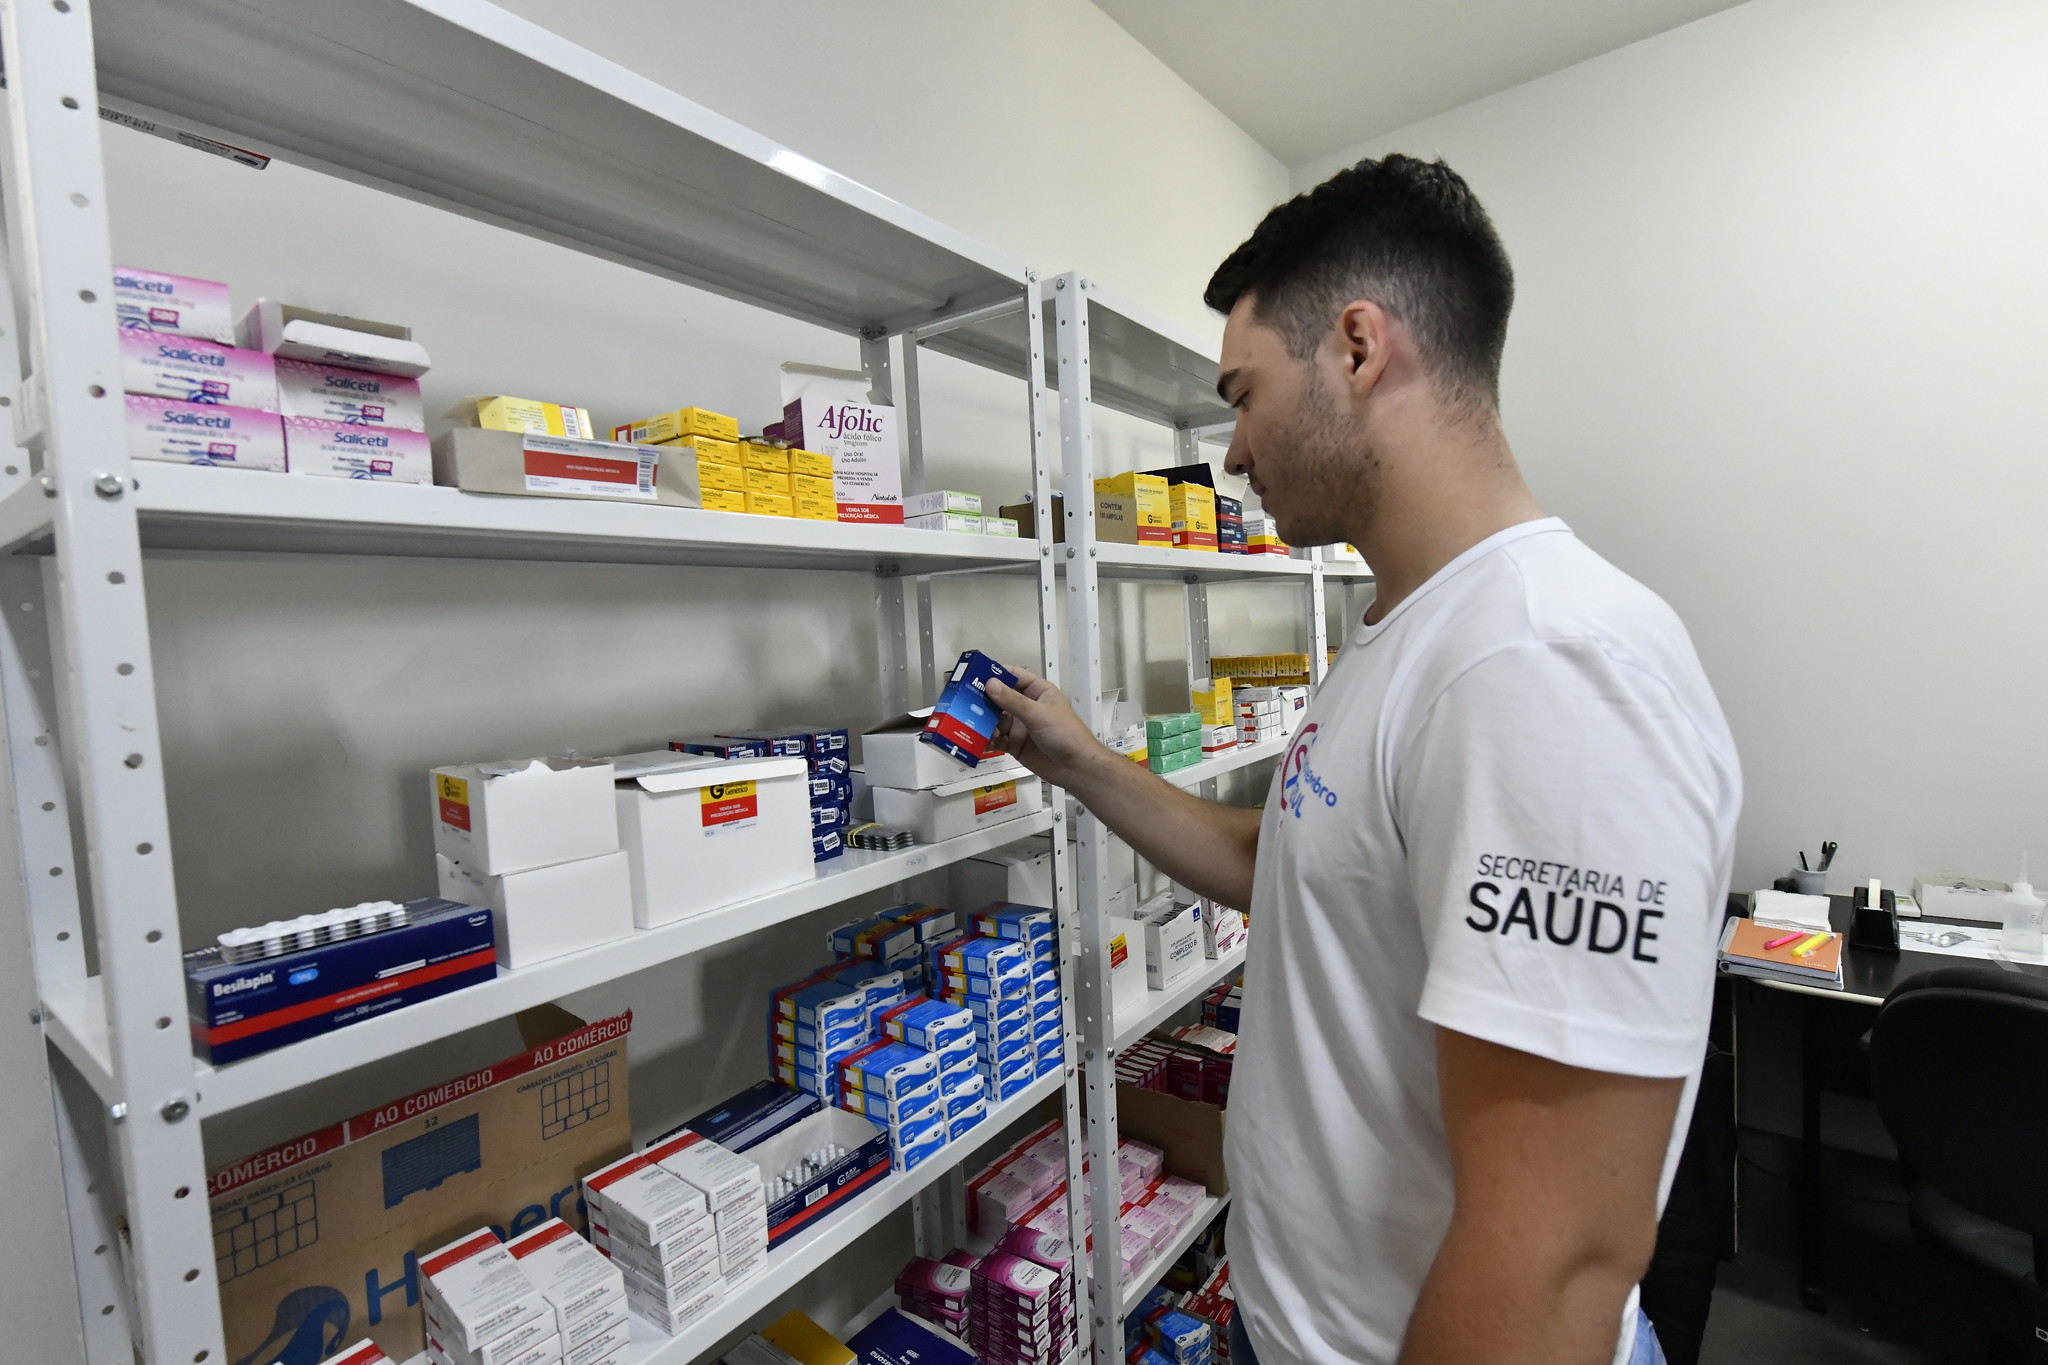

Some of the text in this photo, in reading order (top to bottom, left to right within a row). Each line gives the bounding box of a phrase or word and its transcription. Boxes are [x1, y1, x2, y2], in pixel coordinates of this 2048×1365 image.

[114, 276, 174, 295] alicetil
[159, 345, 225, 367] Salicetil
[325, 375, 380, 393] Salicetil
[164, 410, 231, 429] Salicetil
[334, 431, 388, 448] Salicetil
[843, 431, 882, 442] ácido fólico
[1100, 502, 1123, 511] CONTÉM
[709, 784, 749, 800] G Genérico
[1477, 854, 1669, 905] SECRETARIA DE
[1466, 881, 1665, 964] SAÚDE
[1169, 942, 1194, 960] COMPLEXO
[213, 972, 274, 997] Besilapin
[355, 1005, 370, 1016] 500
[533, 1018, 628, 1066] AO COMÉRCIO
[516, 1075, 552, 1094] CAMADAS
[374, 1069, 493, 1128] AO COMÉRCIO
[424, 1116, 439, 1129] 12
